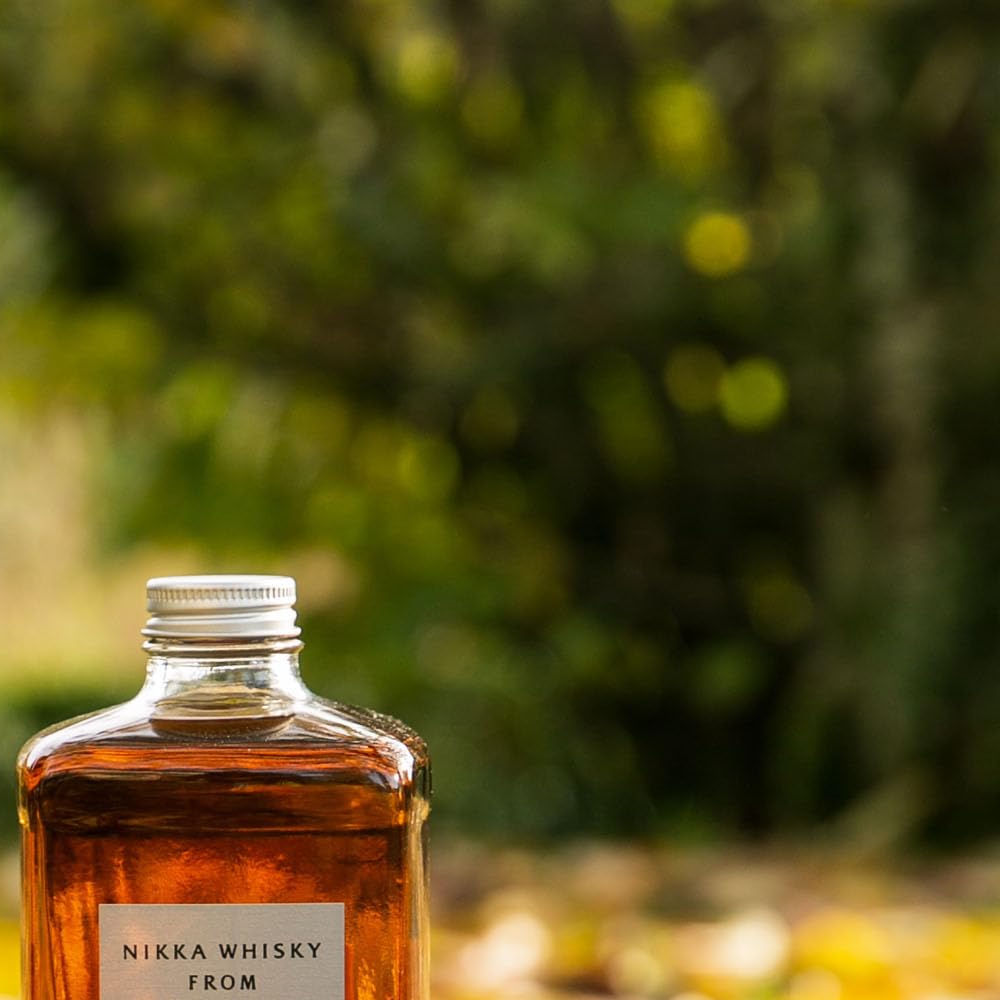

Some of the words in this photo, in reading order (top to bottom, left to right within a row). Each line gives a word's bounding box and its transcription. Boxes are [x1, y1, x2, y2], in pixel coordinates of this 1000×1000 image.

[123, 944, 207, 960] NIKKA
[219, 942, 321, 959] WHISKY
[188, 974, 257, 991] FROM
